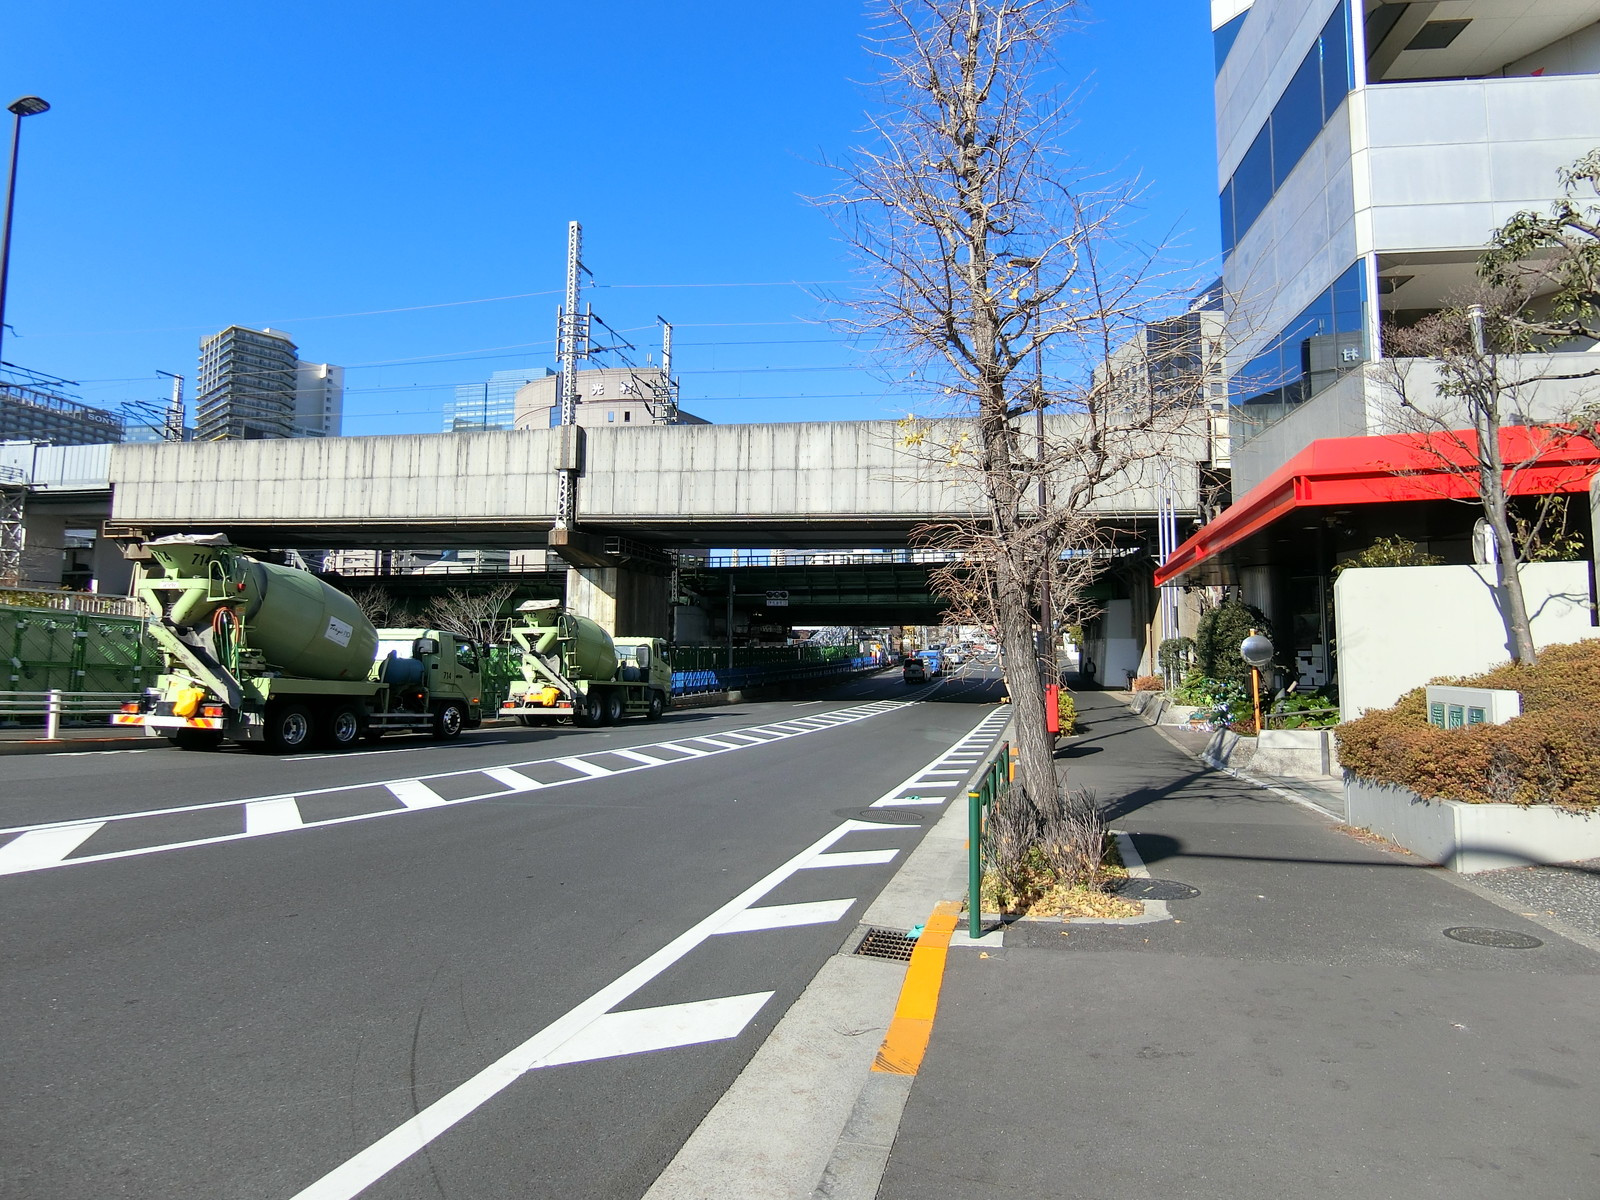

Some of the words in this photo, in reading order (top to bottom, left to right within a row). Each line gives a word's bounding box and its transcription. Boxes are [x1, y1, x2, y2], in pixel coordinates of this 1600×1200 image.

[88, 414, 116, 426] SONY
[191, 553, 213, 567] 714
[443, 671, 452, 680] 714
